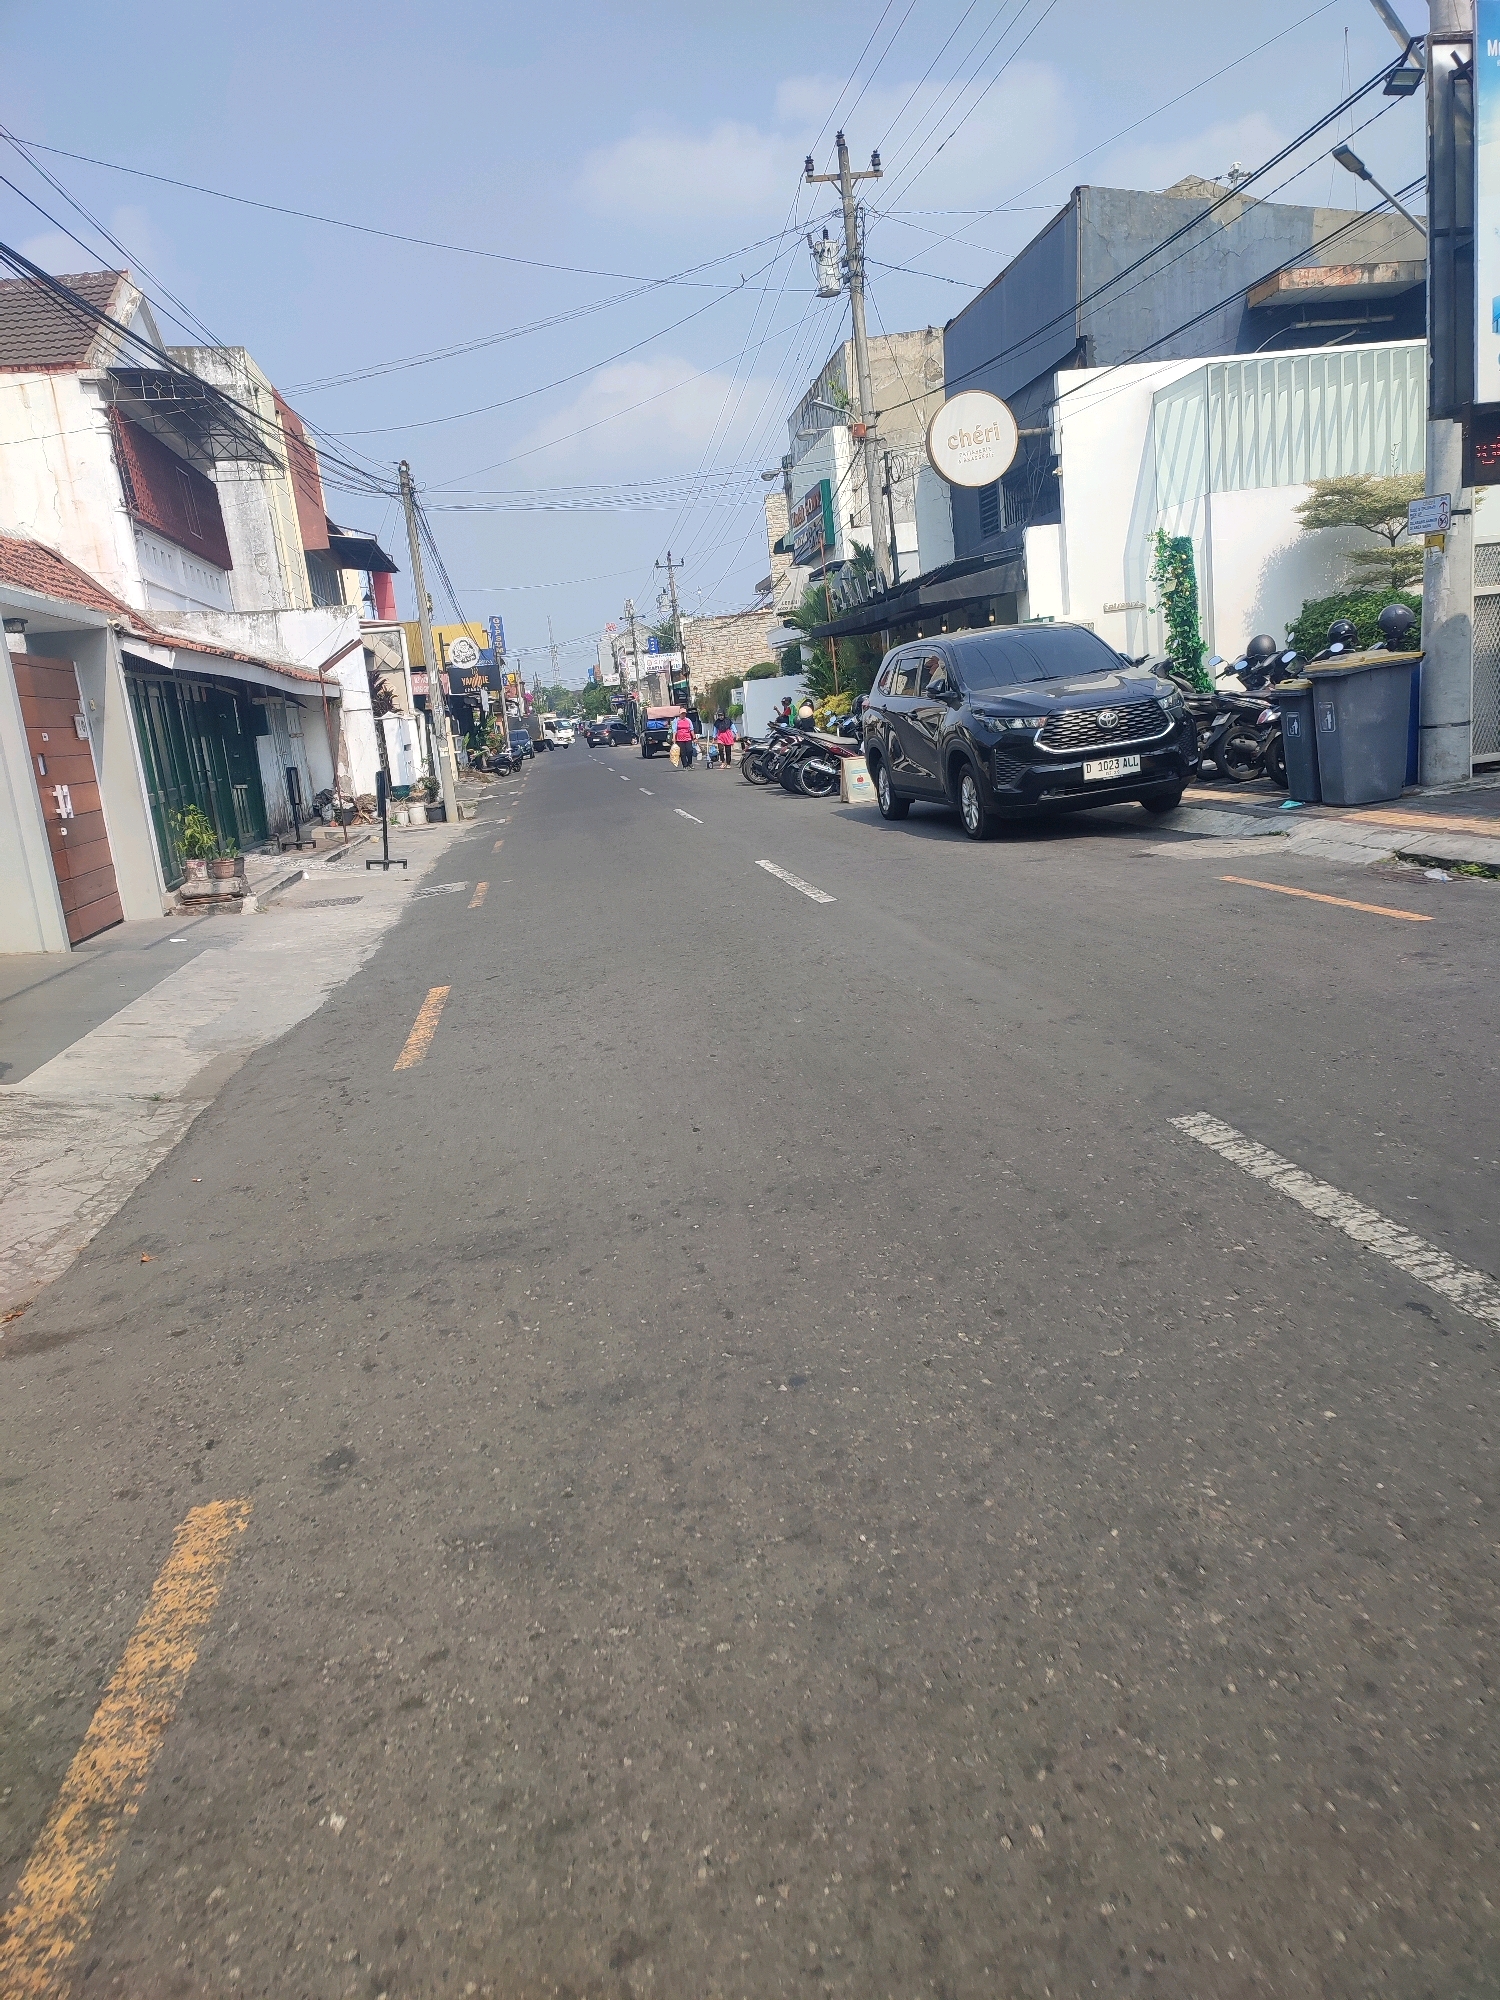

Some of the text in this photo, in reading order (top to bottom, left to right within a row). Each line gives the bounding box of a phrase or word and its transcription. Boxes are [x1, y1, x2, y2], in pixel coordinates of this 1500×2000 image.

[947, 421, 1000, 450] chéri
[1086, 757, 1138, 773] D 1023 ALL
